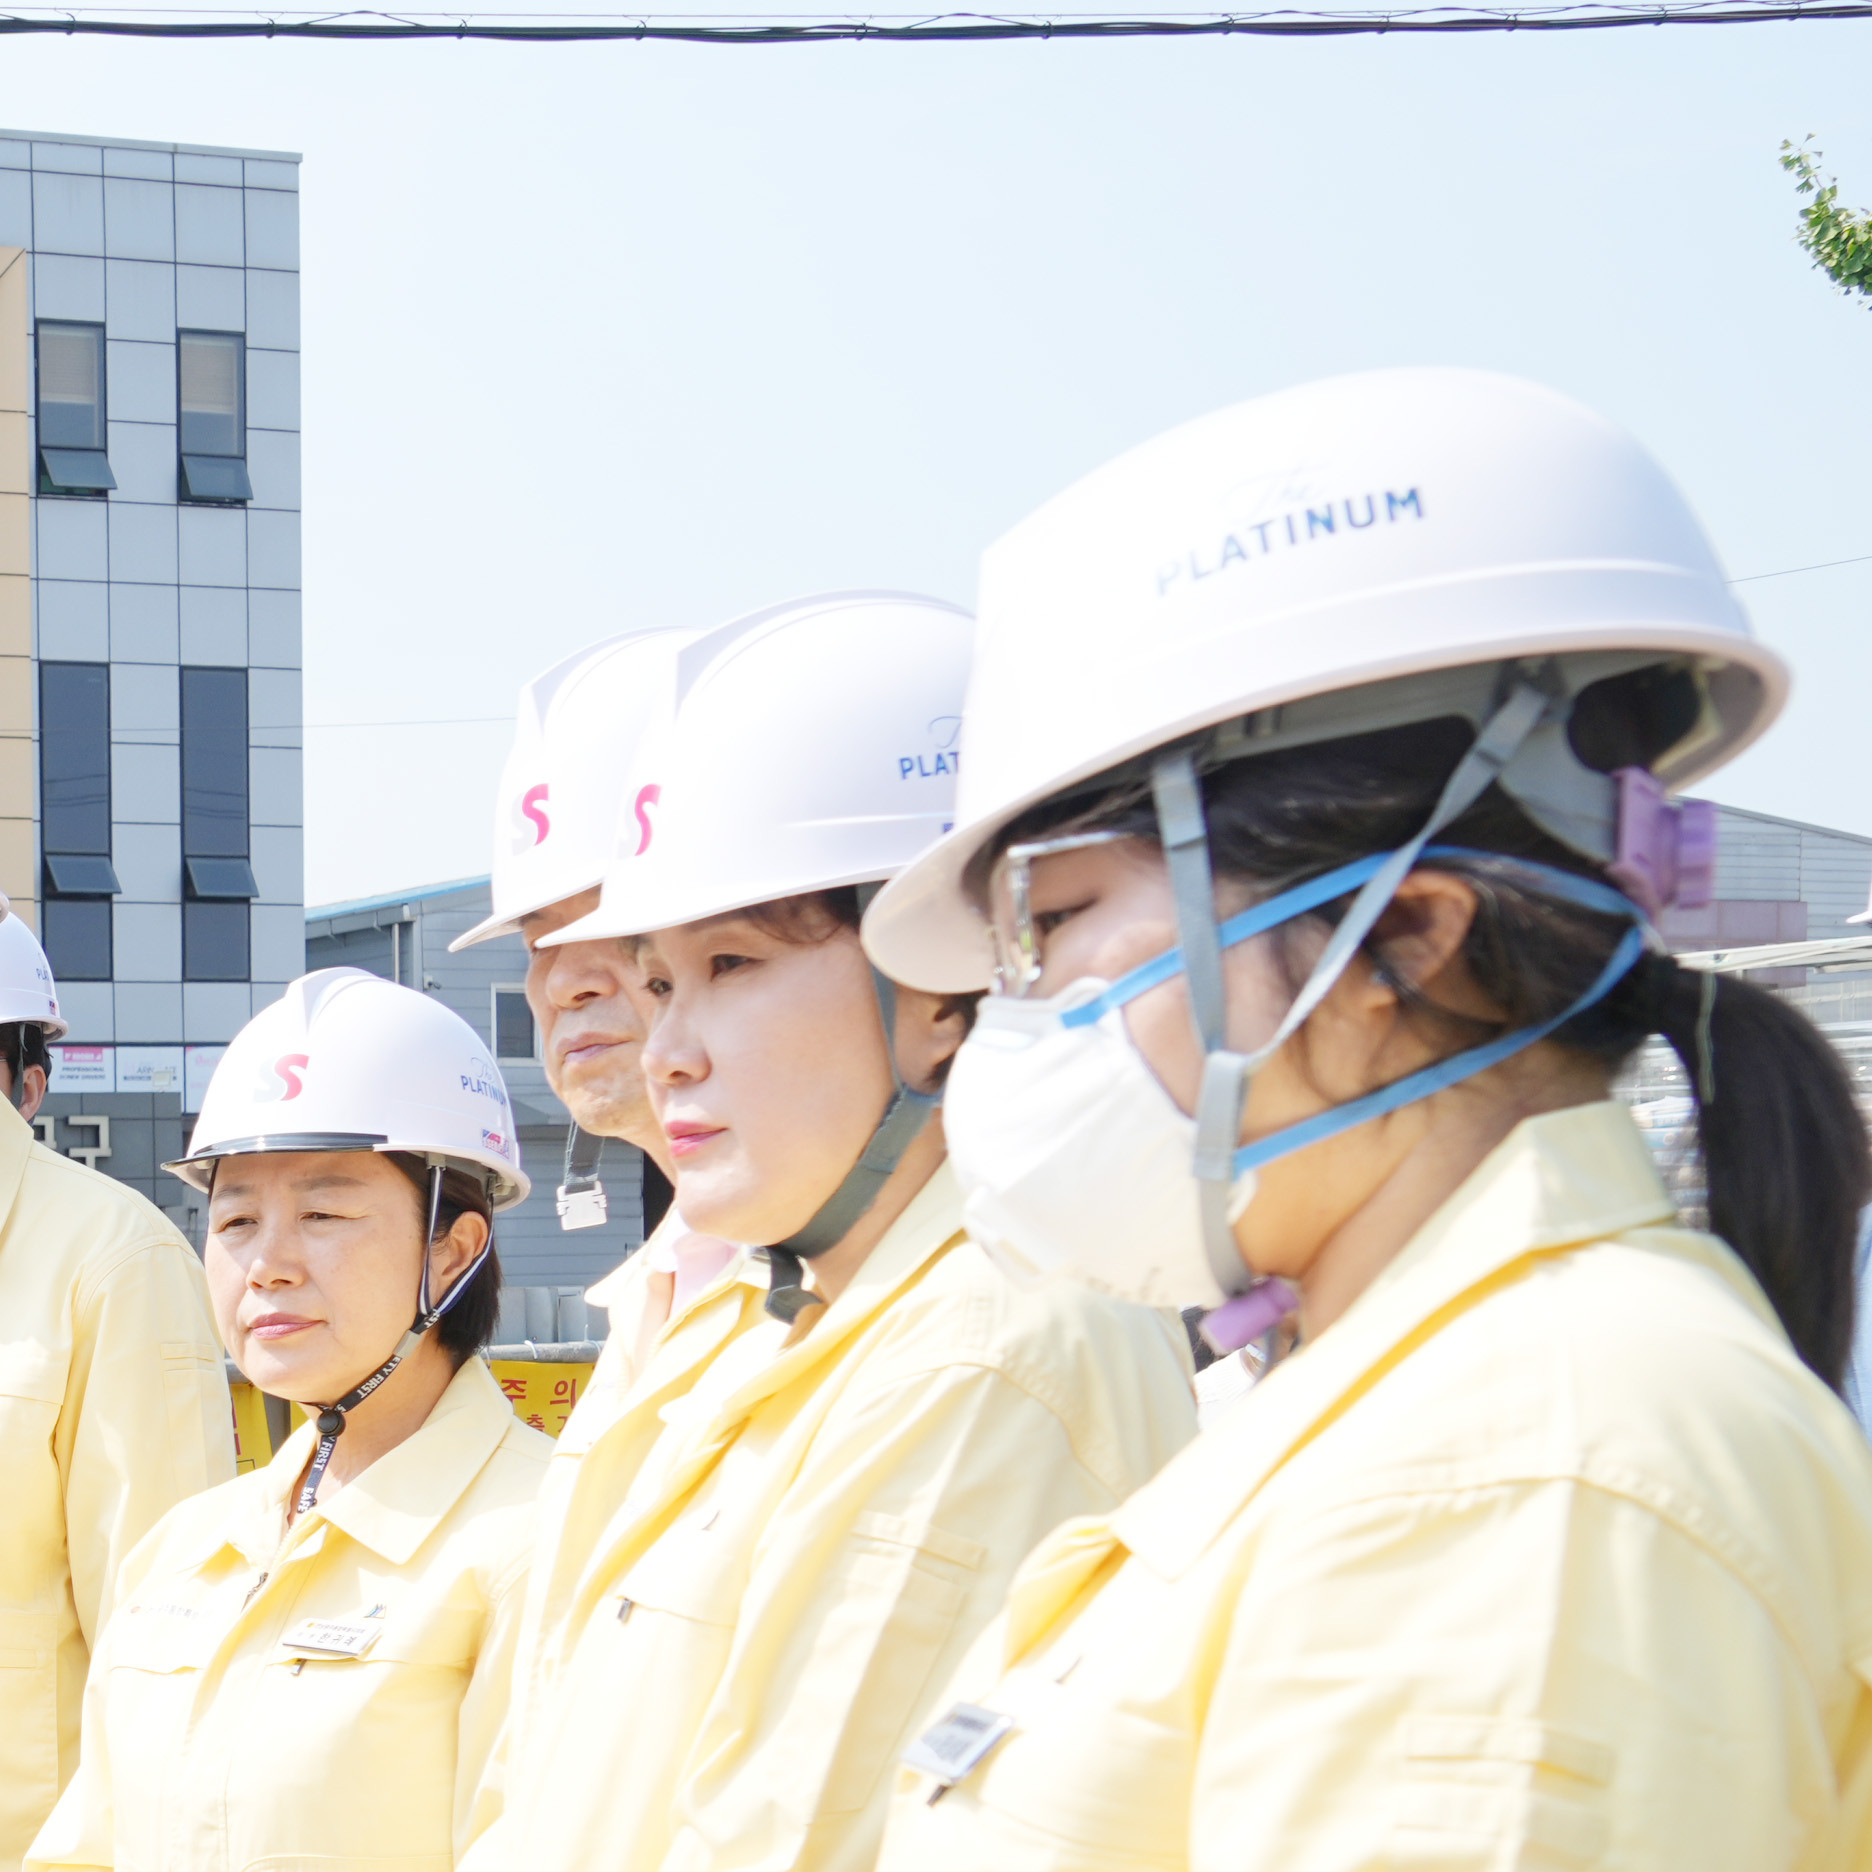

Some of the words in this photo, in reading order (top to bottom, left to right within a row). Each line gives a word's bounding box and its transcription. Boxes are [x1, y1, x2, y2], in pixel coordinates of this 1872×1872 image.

[1154, 484, 1427, 596] PLATINUM
[356, 1373, 389, 1400] FIRST
[312, 1441, 334, 1472] FIRST
